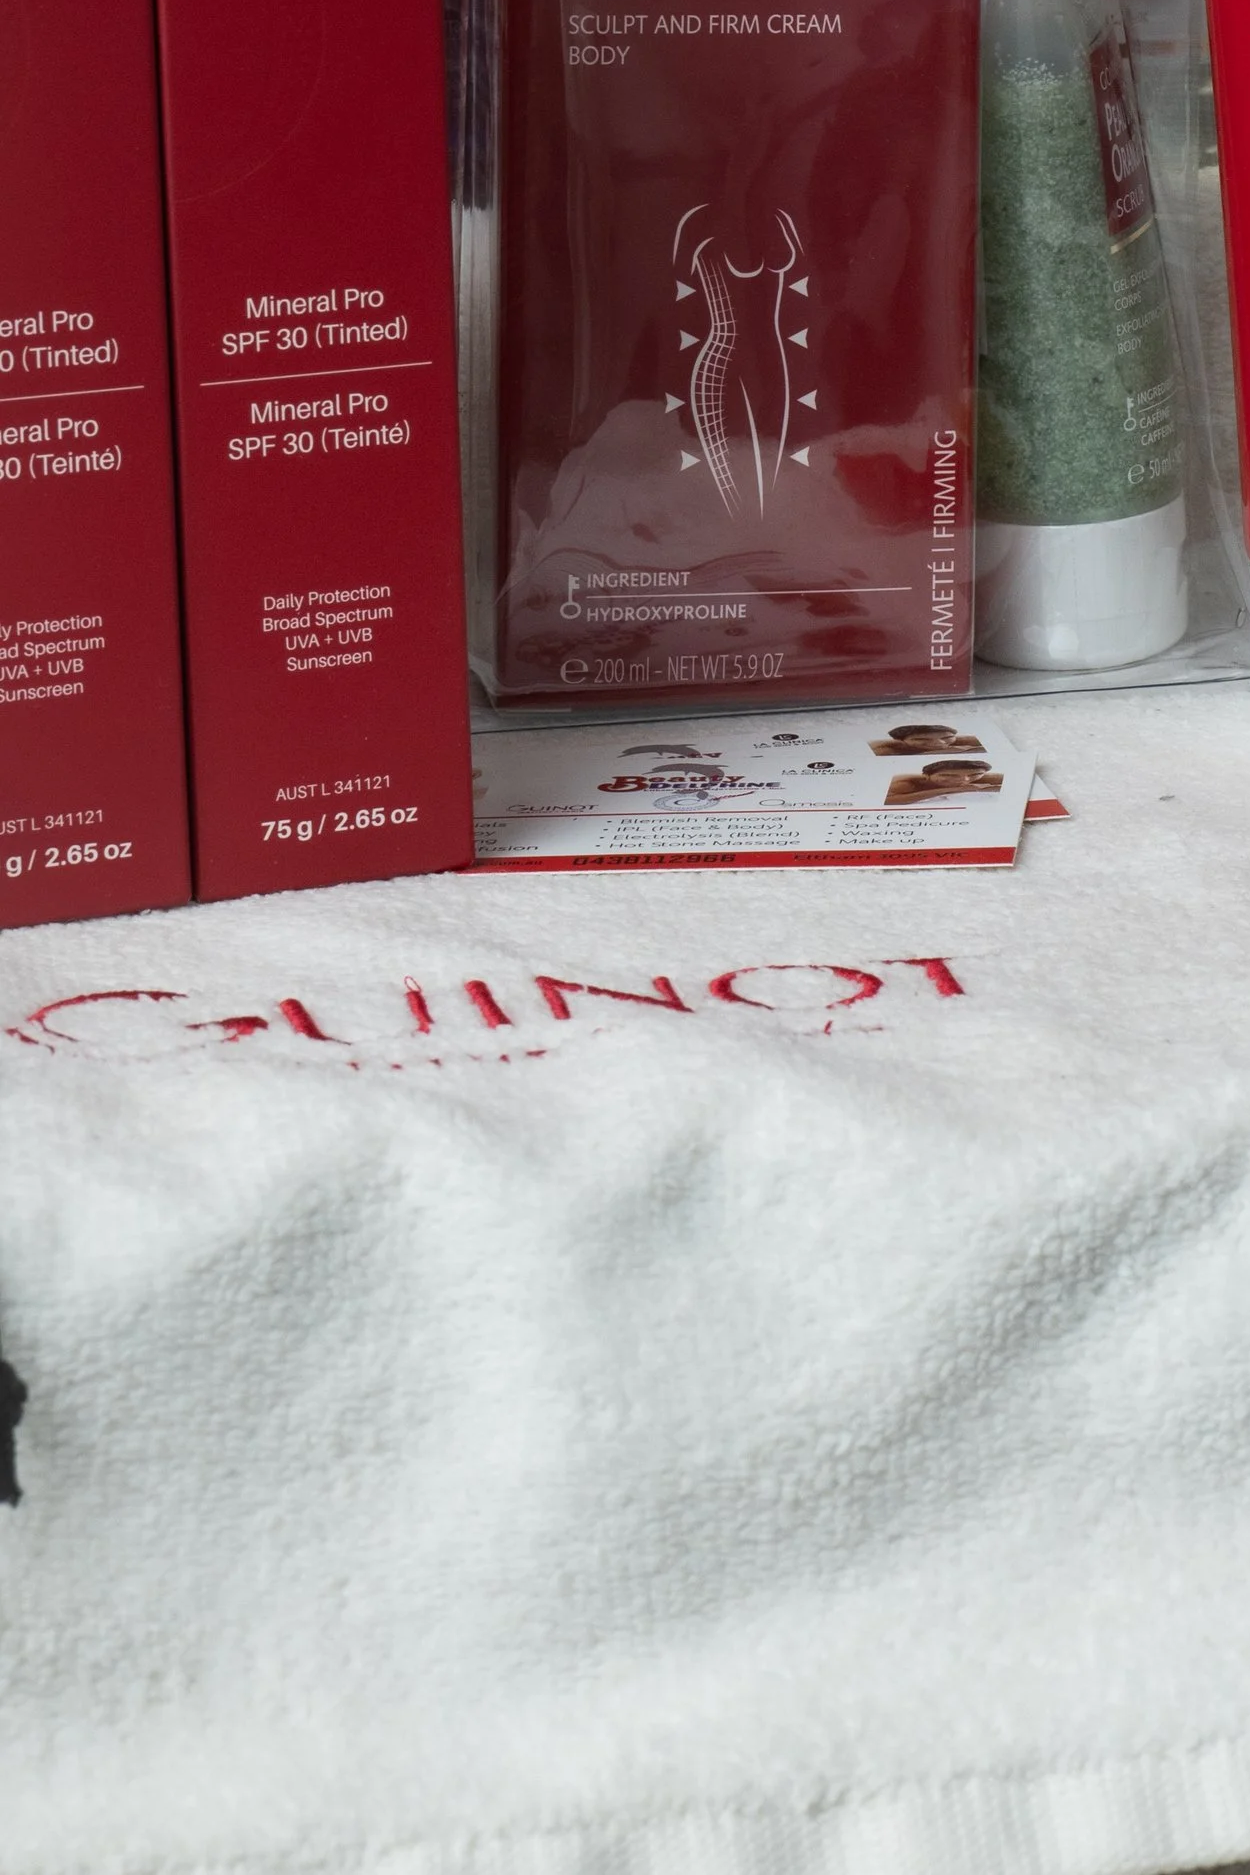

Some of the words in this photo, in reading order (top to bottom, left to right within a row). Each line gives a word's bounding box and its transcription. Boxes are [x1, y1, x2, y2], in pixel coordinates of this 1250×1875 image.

[569, 15, 648, 35] SCULPT
[654, 14, 702, 34] AND
[708, 14, 761, 34] FIRM
[767, 13, 843, 34] CREAM
[568, 46, 630, 66] BODY
[246, 288, 339, 320] Mineral
[345, 287, 385, 311] Pro
[222, 329, 270, 356] SPF
[277, 326, 309, 351] 30
[314, 315, 409, 349] (Tinted)
[250, 393, 343, 425] Mineral
[349, 392, 389, 416] Pro
[228, 436, 277, 462] SPF
[284, 431, 314, 456] 30
[320, 420, 412, 454] (Teinté)
[932, 428, 957, 539] FIRMING
[587, 571, 690, 588] INGREDIENT
[263, 591, 305, 614] Daily
[308, 584, 391, 608] Protection
[586, 603, 747, 622] HYDROXYPROLINE
[928, 561, 954, 671] FERMETÉ
[286, 650, 373, 673] Sunscreen
[276, 783, 316, 803] AUST
[321, 782, 331, 799] L
[334, 775, 392, 796] 341121
[620, 816, 699, 825] Blemish
[705, 814, 790, 823] Removal
[608, 840, 645, 849] Hot
[842, 828, 914, 838] Waxing
